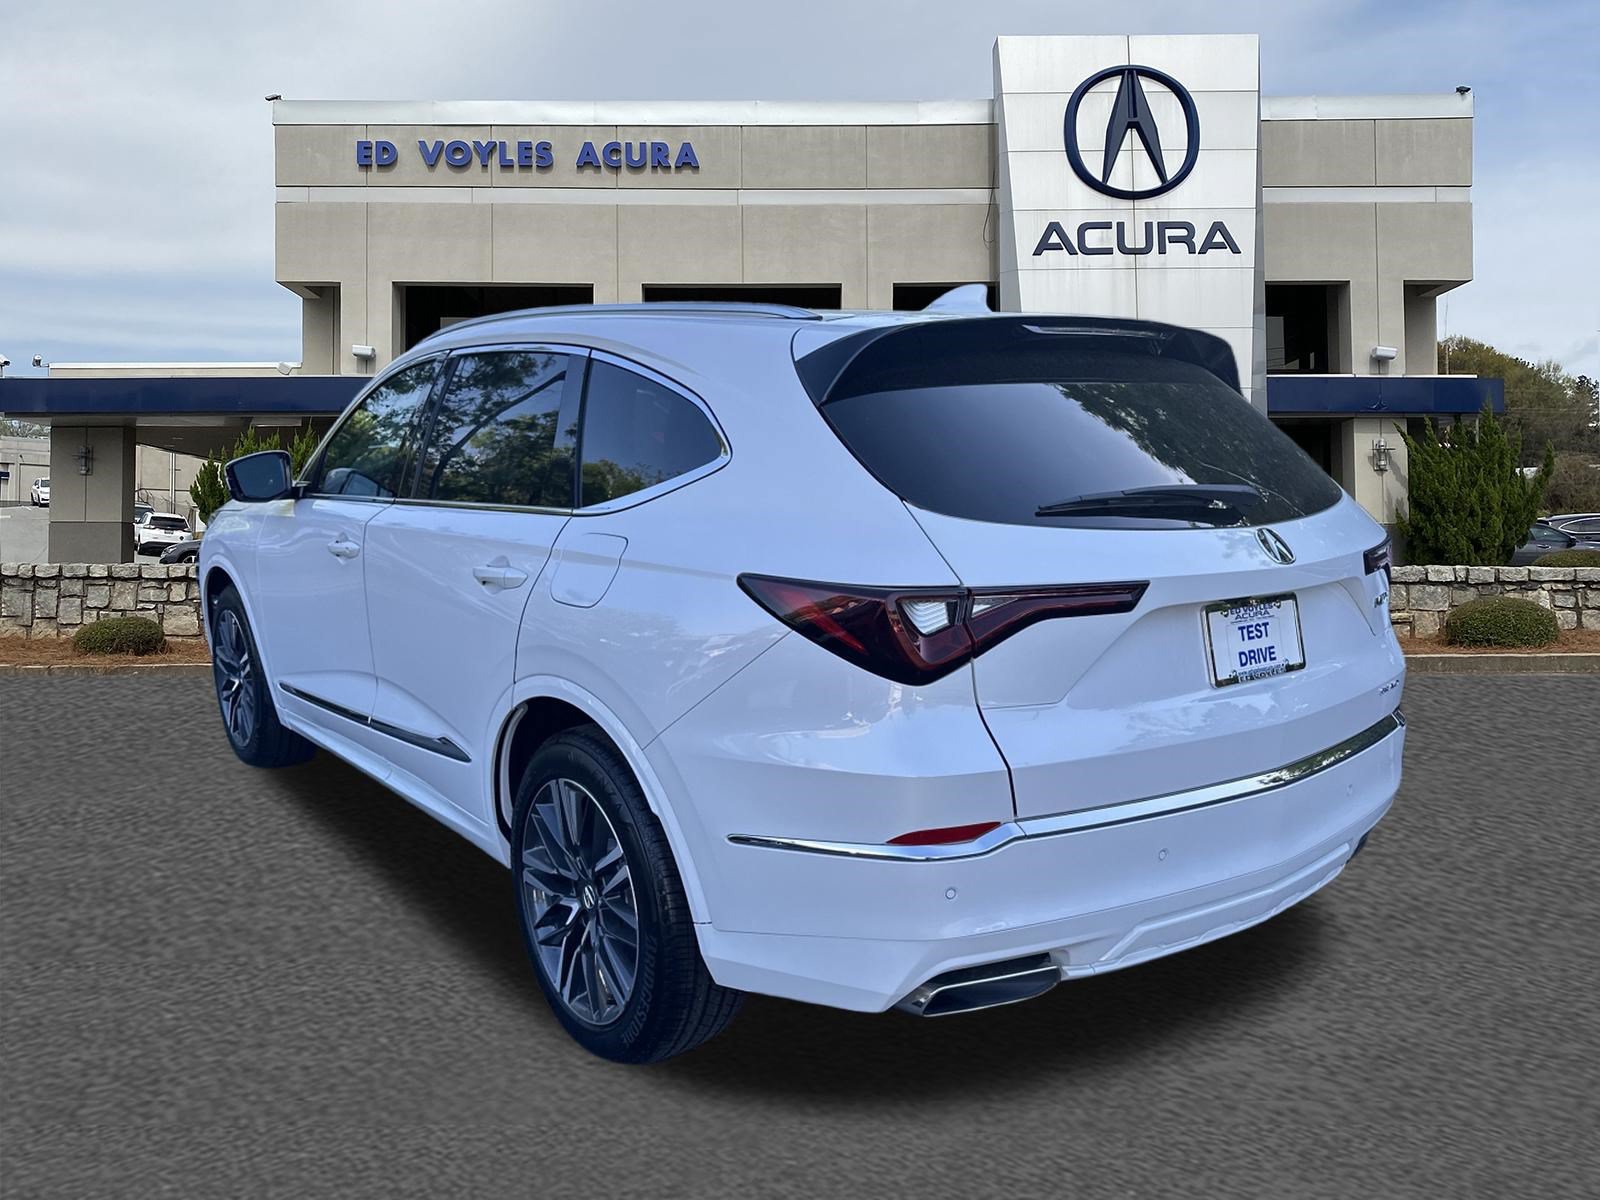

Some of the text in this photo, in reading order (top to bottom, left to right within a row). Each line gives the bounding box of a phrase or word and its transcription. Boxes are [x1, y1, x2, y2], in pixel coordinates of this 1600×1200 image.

[356, 140, 700, 169] ED VOYLES ACURA
[1032, 221, 1242, 256] ACURA
[1235, 610, 1271, 620] ACURA
[1238, 622, 1270, 642] TEST
[1238, 646, 1277, 667] DRIVE
